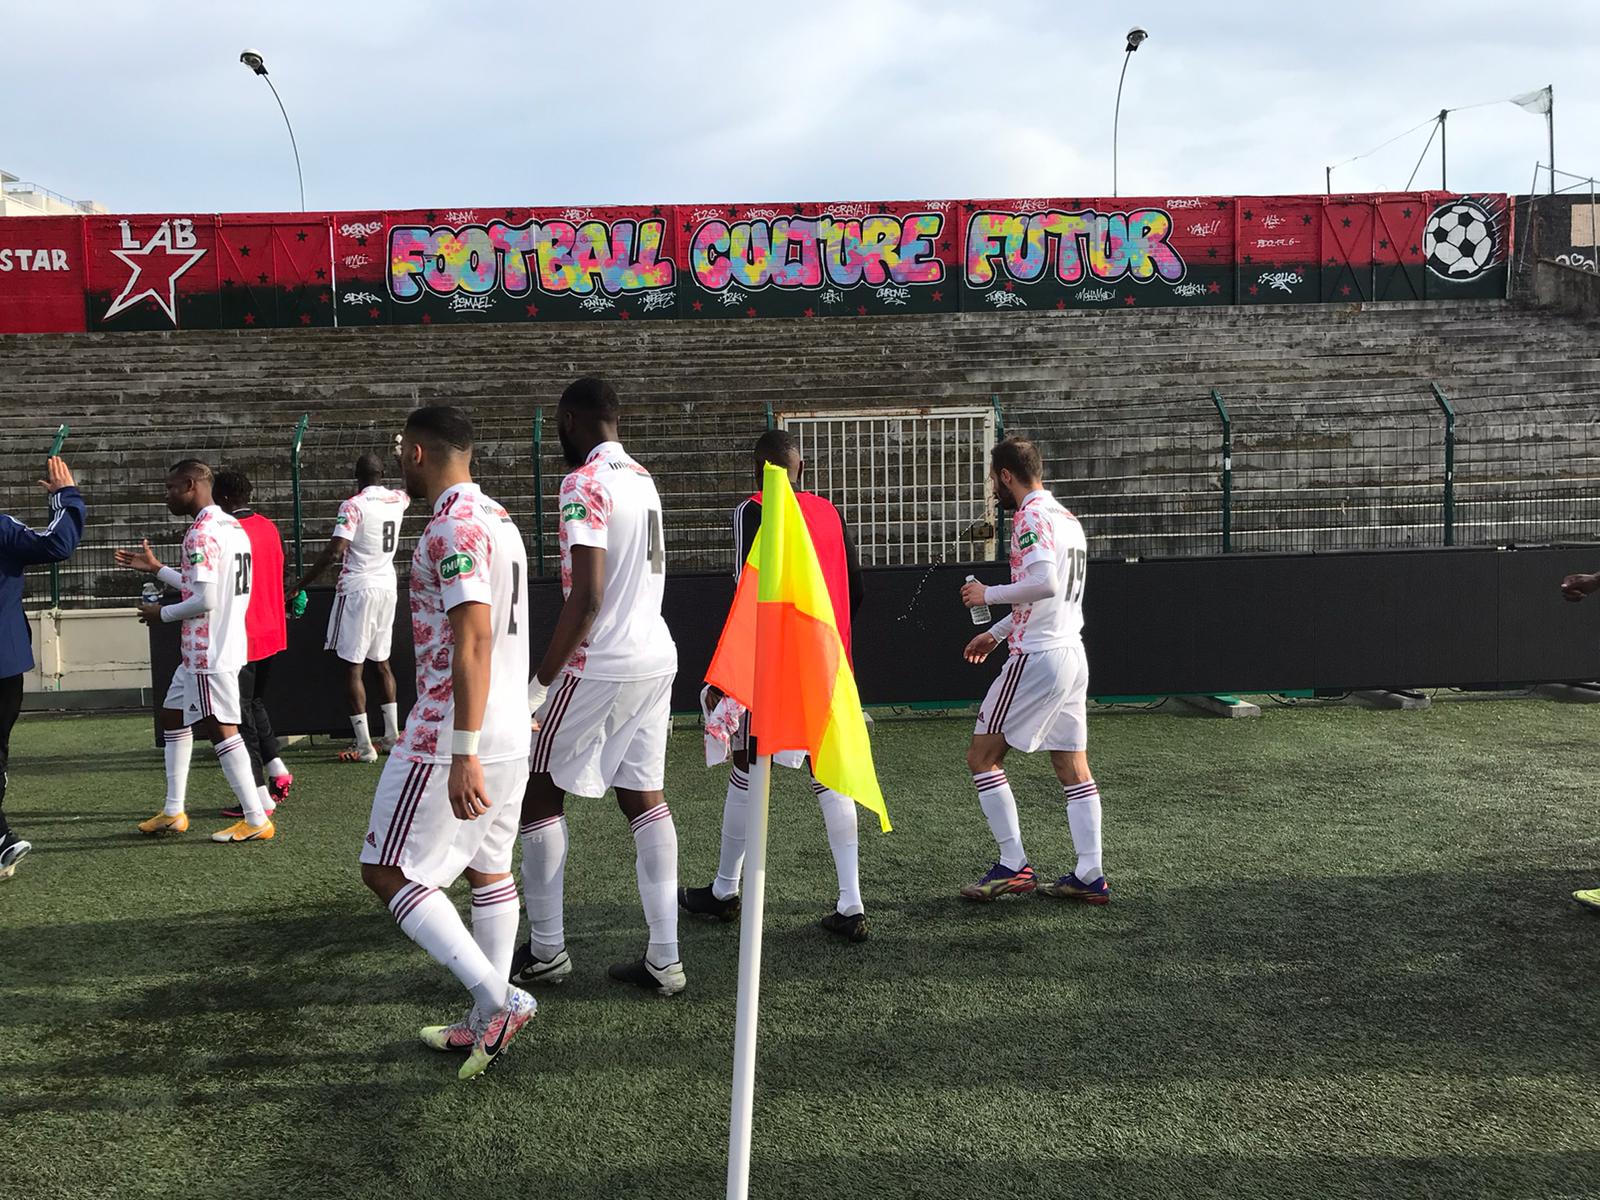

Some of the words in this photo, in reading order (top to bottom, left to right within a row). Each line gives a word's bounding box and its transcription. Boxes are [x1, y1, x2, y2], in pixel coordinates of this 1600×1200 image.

[119, 219, 197, 254] LAB
[386, 218, 677, 303] FOOTBALL
[689, 211, 946, 294] CULTURE
[964, 207, 1187, 290] FUTUR
[0, 249, 70, 272] STAR
[383, 521, 395, 553] 8
[647, 509, 664, 575] 4
[235, 553, 251, 596] 20
[1065, 547, 1086, 603] 19
